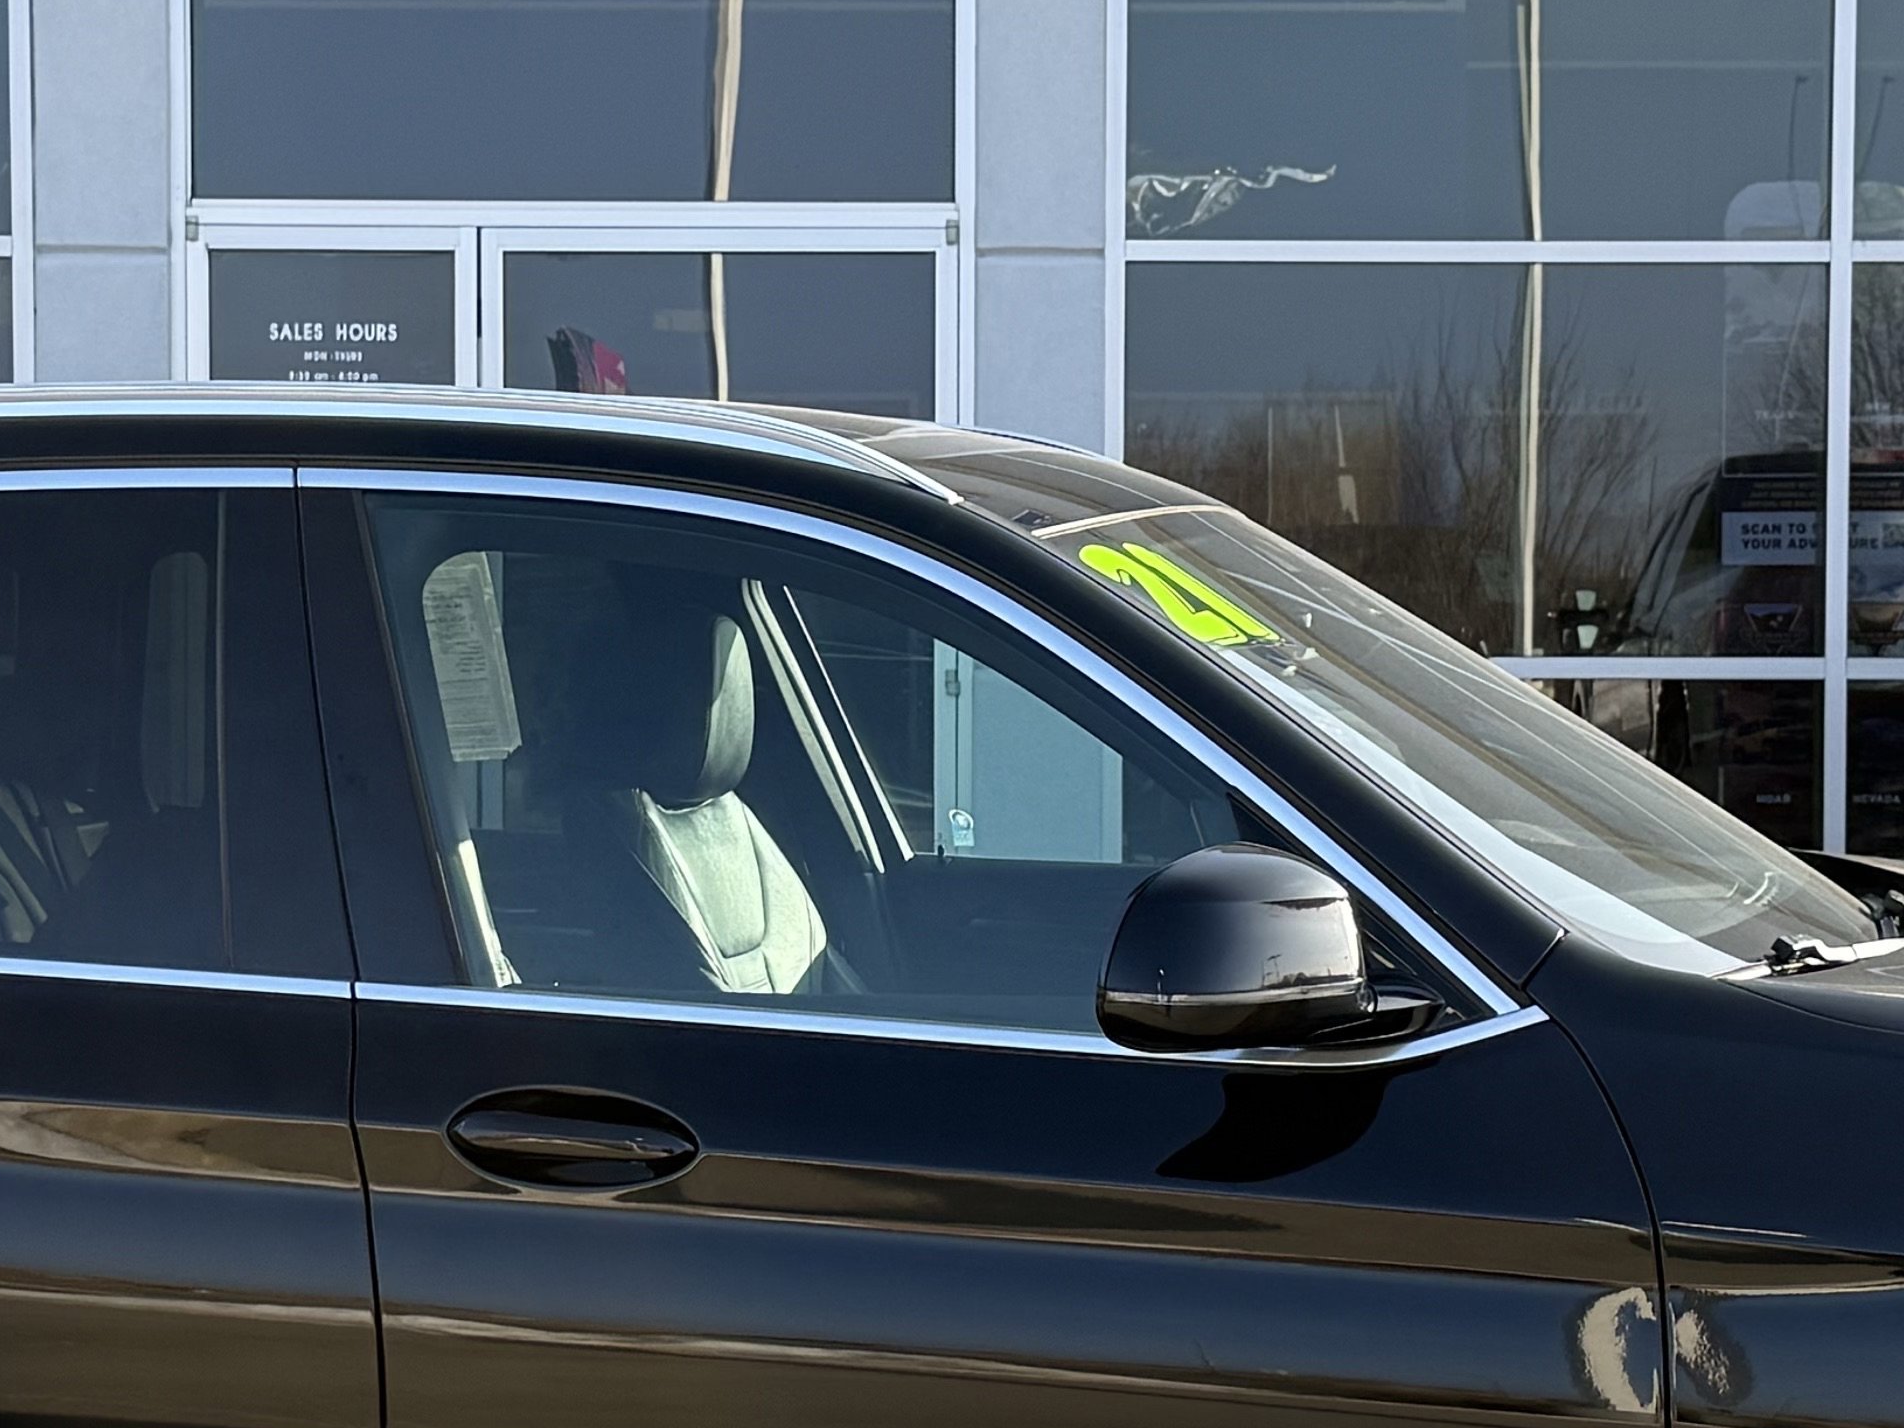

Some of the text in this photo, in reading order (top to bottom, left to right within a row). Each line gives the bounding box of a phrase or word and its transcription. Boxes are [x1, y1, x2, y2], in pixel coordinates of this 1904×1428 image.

[269, 322, 398, 341] SALES HOURS
[1741, 523, 1782, 536] SCAN
[1788, 524, 1807, 535] TO
[1741, 538, 1782, 550] YOUR
[1078, 541, 1281, 647] 21
